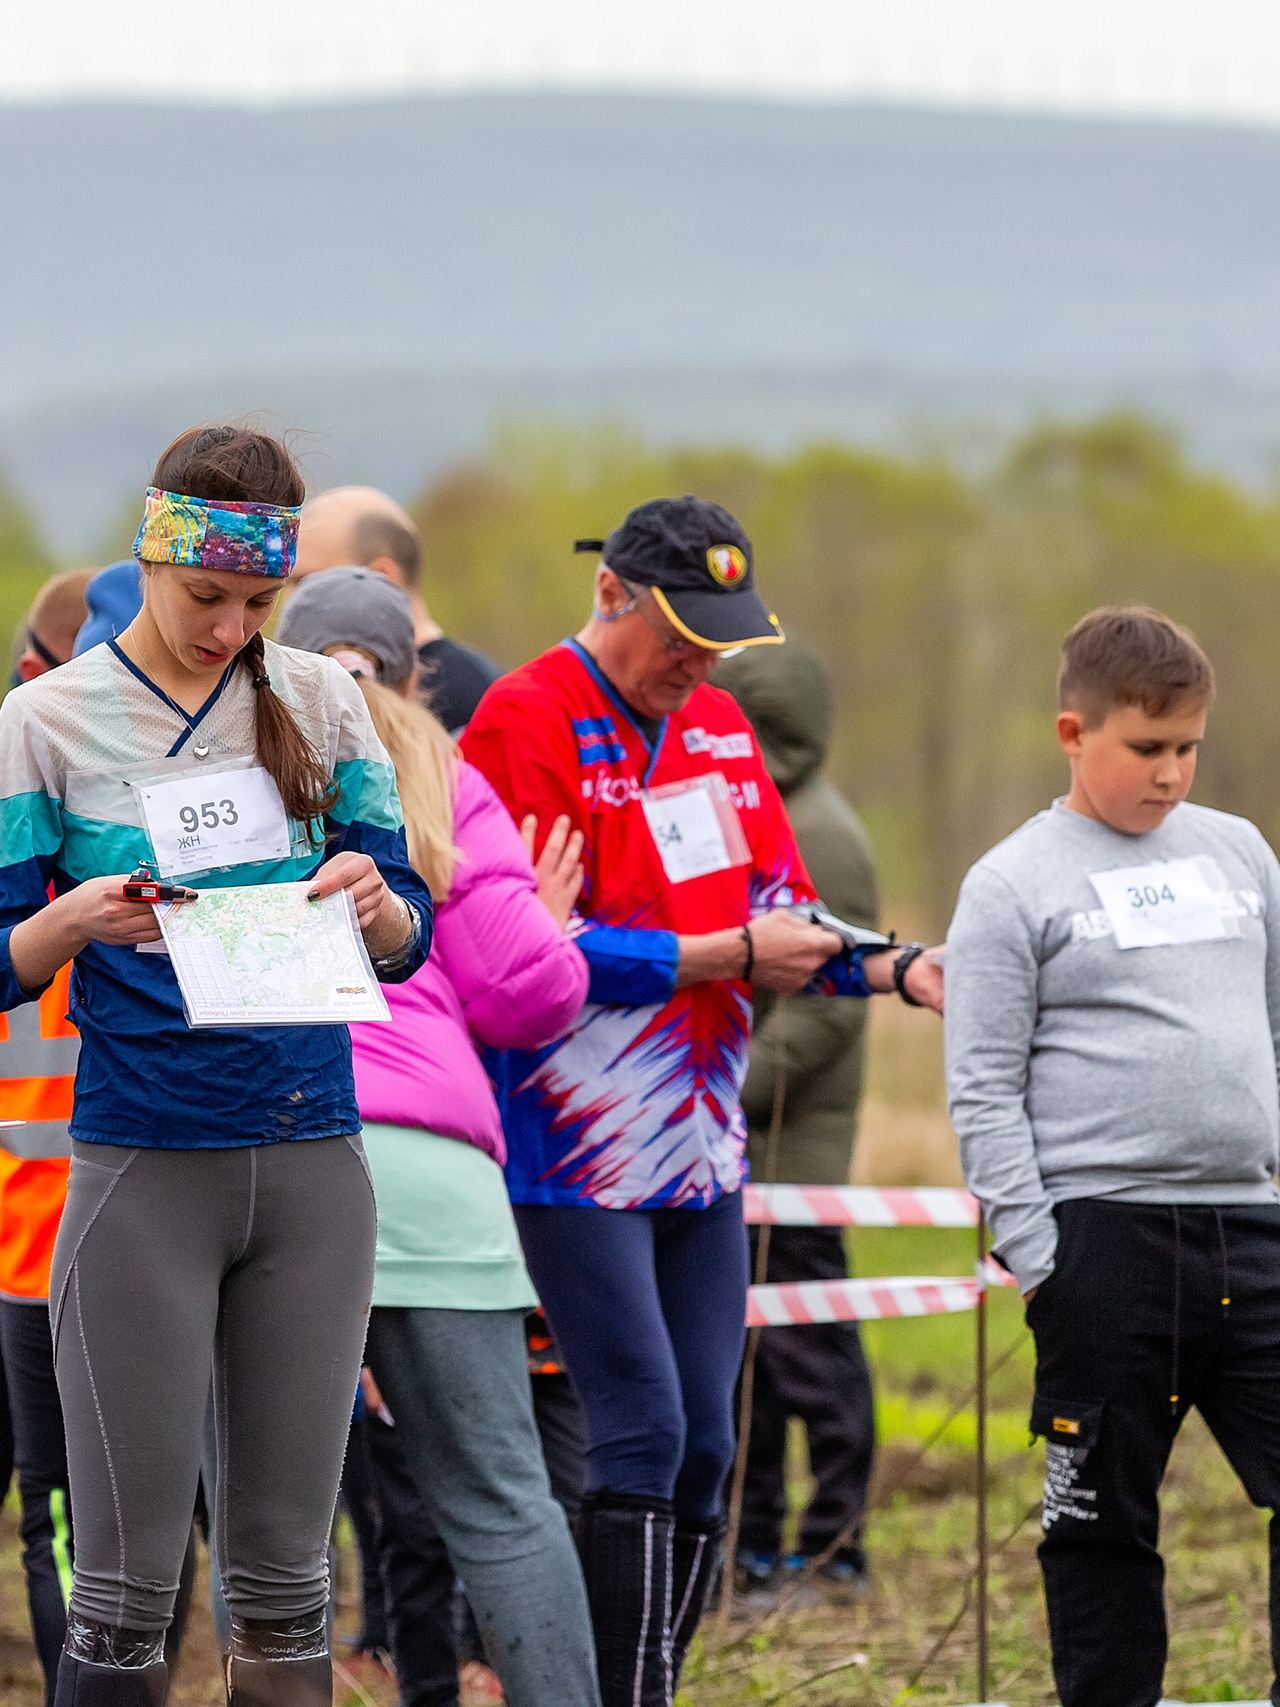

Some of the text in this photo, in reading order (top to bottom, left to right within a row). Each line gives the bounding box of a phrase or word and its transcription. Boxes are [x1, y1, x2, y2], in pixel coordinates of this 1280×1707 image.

[179, 799, 239, 833] 953
[177, 834, 201, 850] ЖН
[1127, 884, 1175, 908] 304
